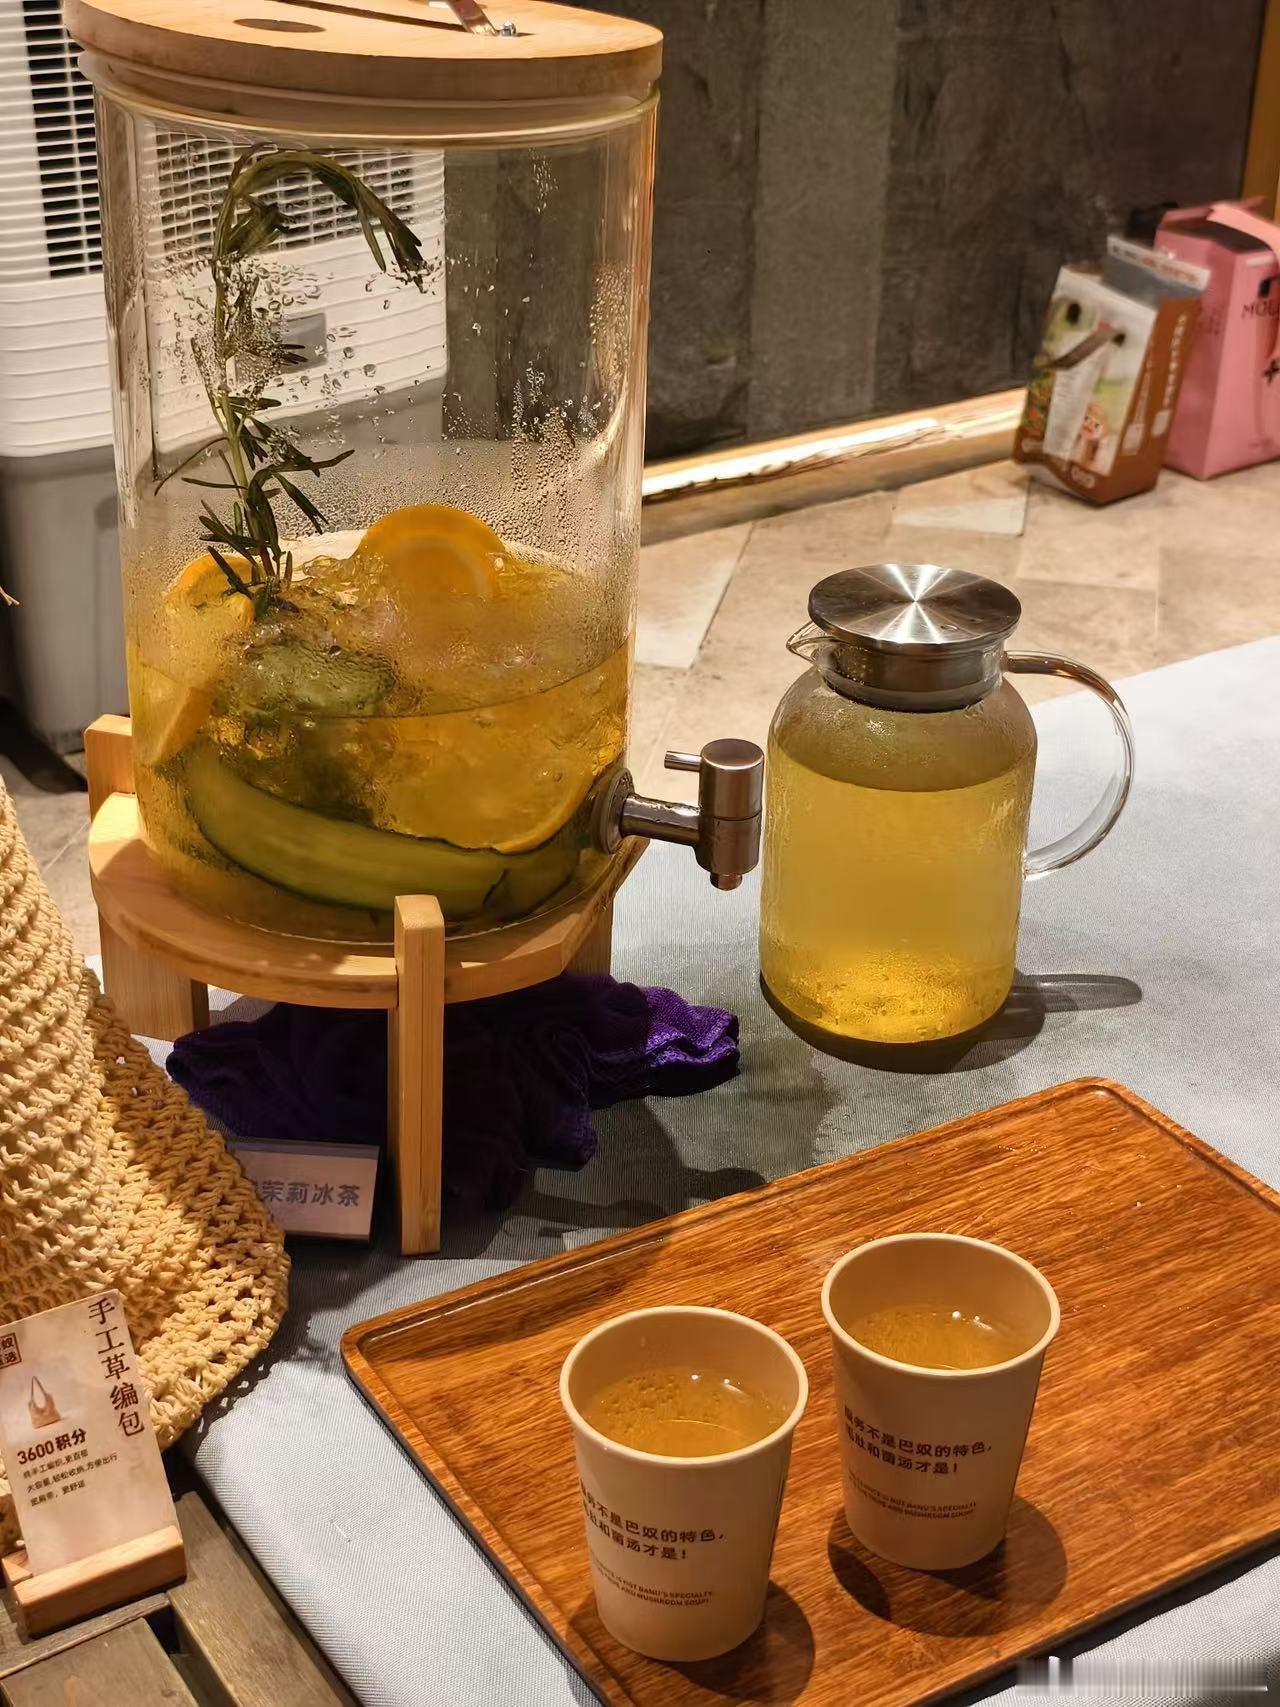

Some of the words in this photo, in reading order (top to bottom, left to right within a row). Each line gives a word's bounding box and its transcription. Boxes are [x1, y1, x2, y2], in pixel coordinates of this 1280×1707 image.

[88, 1297, 145, 1438] 手工草编包
[17, 1428, 87, 1466] 3600积分
